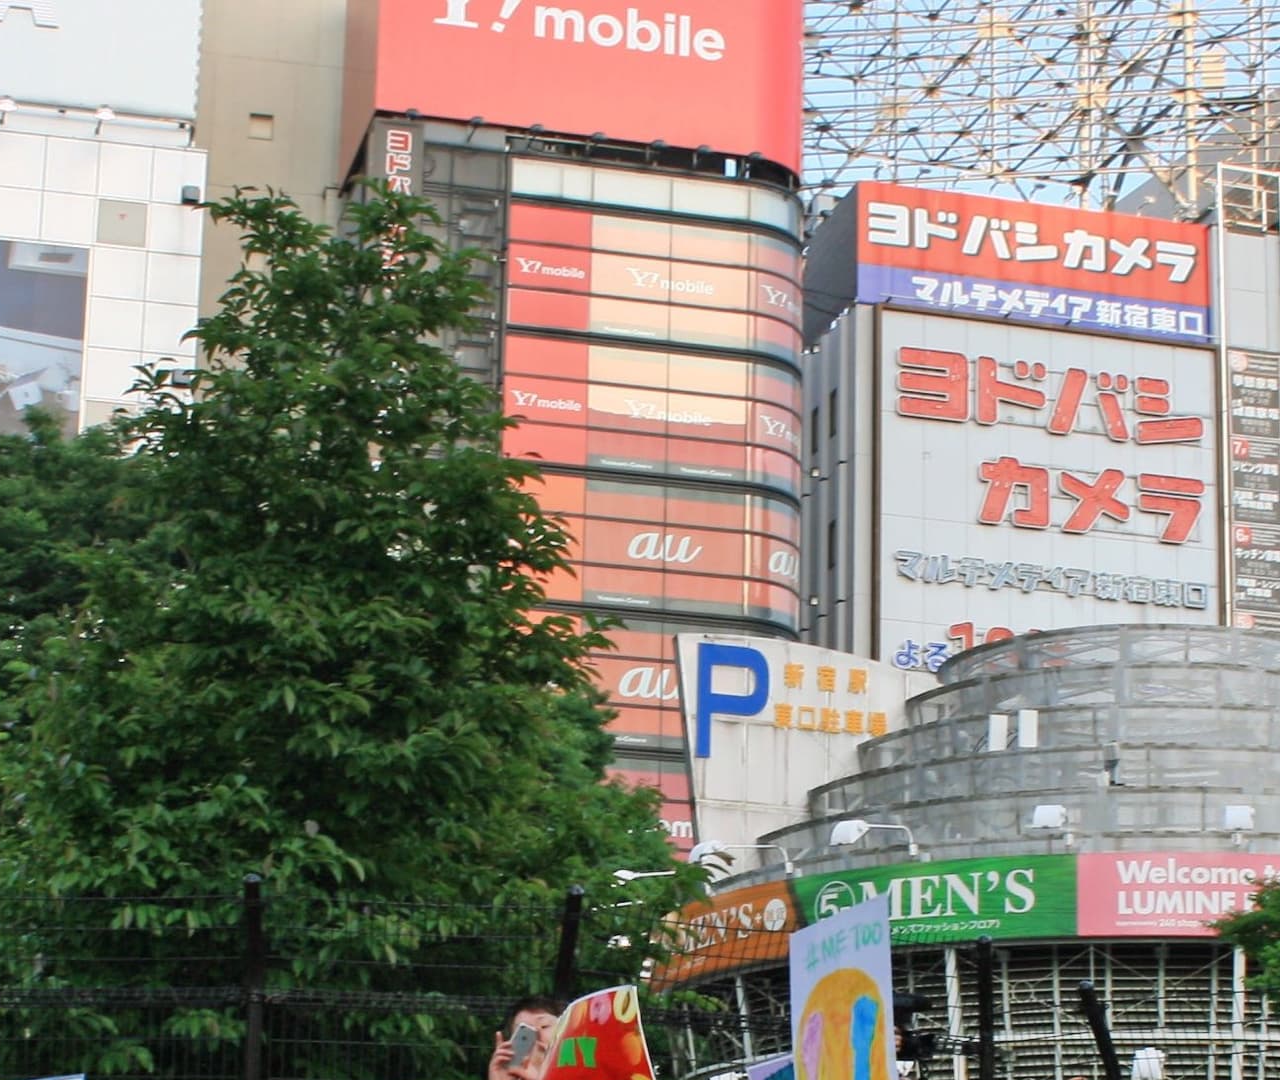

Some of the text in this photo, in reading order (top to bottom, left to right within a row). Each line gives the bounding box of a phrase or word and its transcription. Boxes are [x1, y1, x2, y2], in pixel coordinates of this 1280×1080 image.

[867, 200, 1197, 284] ヨドバシカメラ
[516, 256, 586, 281] Y!mobile
[625, 267, 714, 297] Y!mobile
[911, 277, 1206, 338] マルチメディア新宿東口
[512, 389, 582, 414] Y!mobile
[896, 345, 1206, 445] ヨドバシ
[624, 399, 713, 427] Y!mobile
[978, 456, 1206, 545] カメラ
[627, 531, 703, 565] au
[893, 549, 1209, 611] マルチメディア新宿東口
[784, 663, 869, 695] 新宿駅
[696, 642, 770, 759] P
[775, 703, 889, 738] 東口駐車場
[1116, 858, 1258, 885] Welcome
[858, 868, 1036, 921] MEN'S
[854, 922, 883, 953] TOO
[557, 1037, 598, 1068] MY
